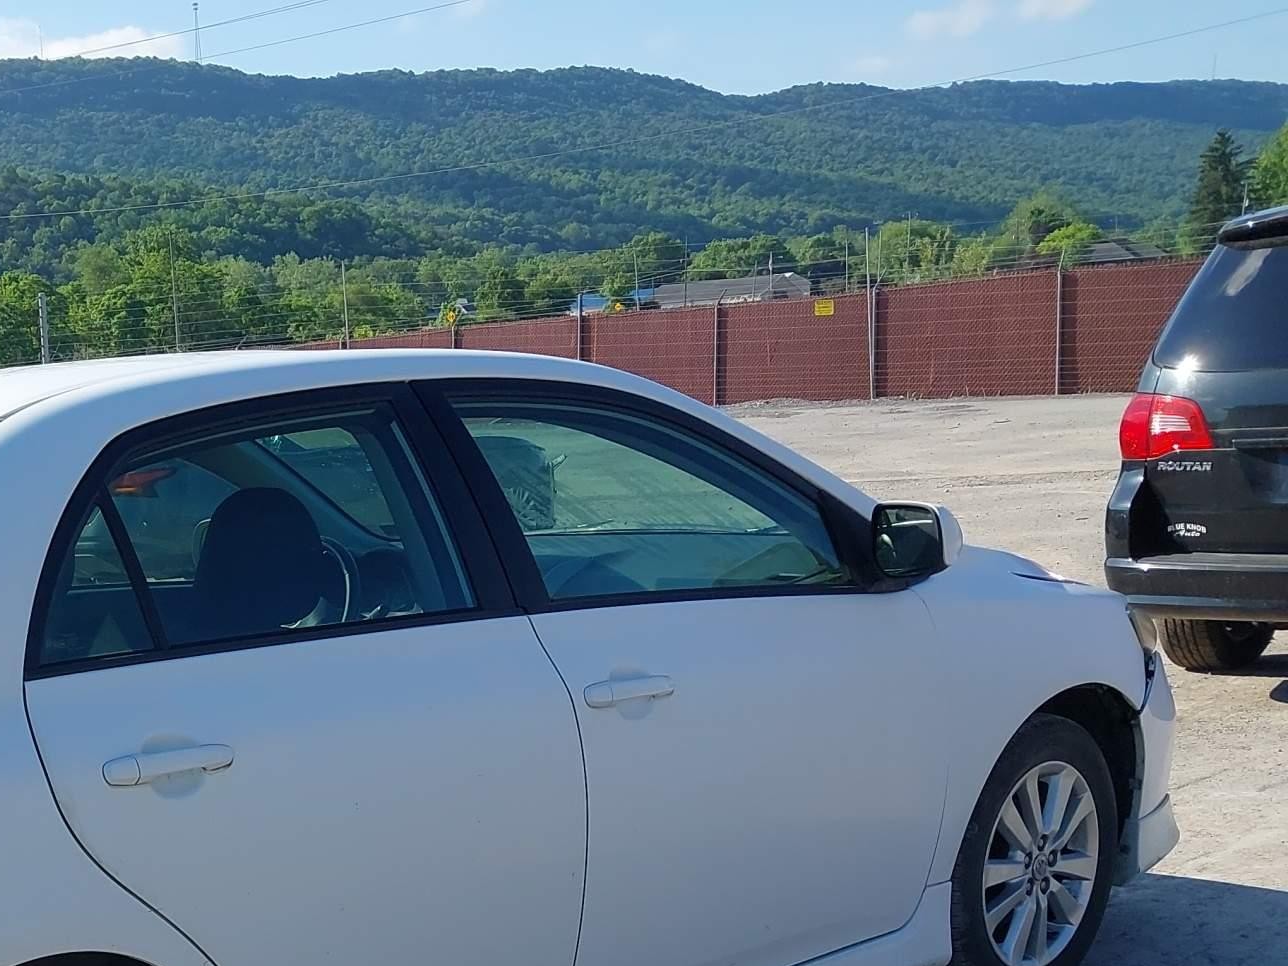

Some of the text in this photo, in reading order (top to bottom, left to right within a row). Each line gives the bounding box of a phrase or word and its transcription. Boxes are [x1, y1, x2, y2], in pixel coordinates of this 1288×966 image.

[1158, 461, 1212, 471] ROUTAN
[1167, 522, 1207, 534] BLUE KNOB
